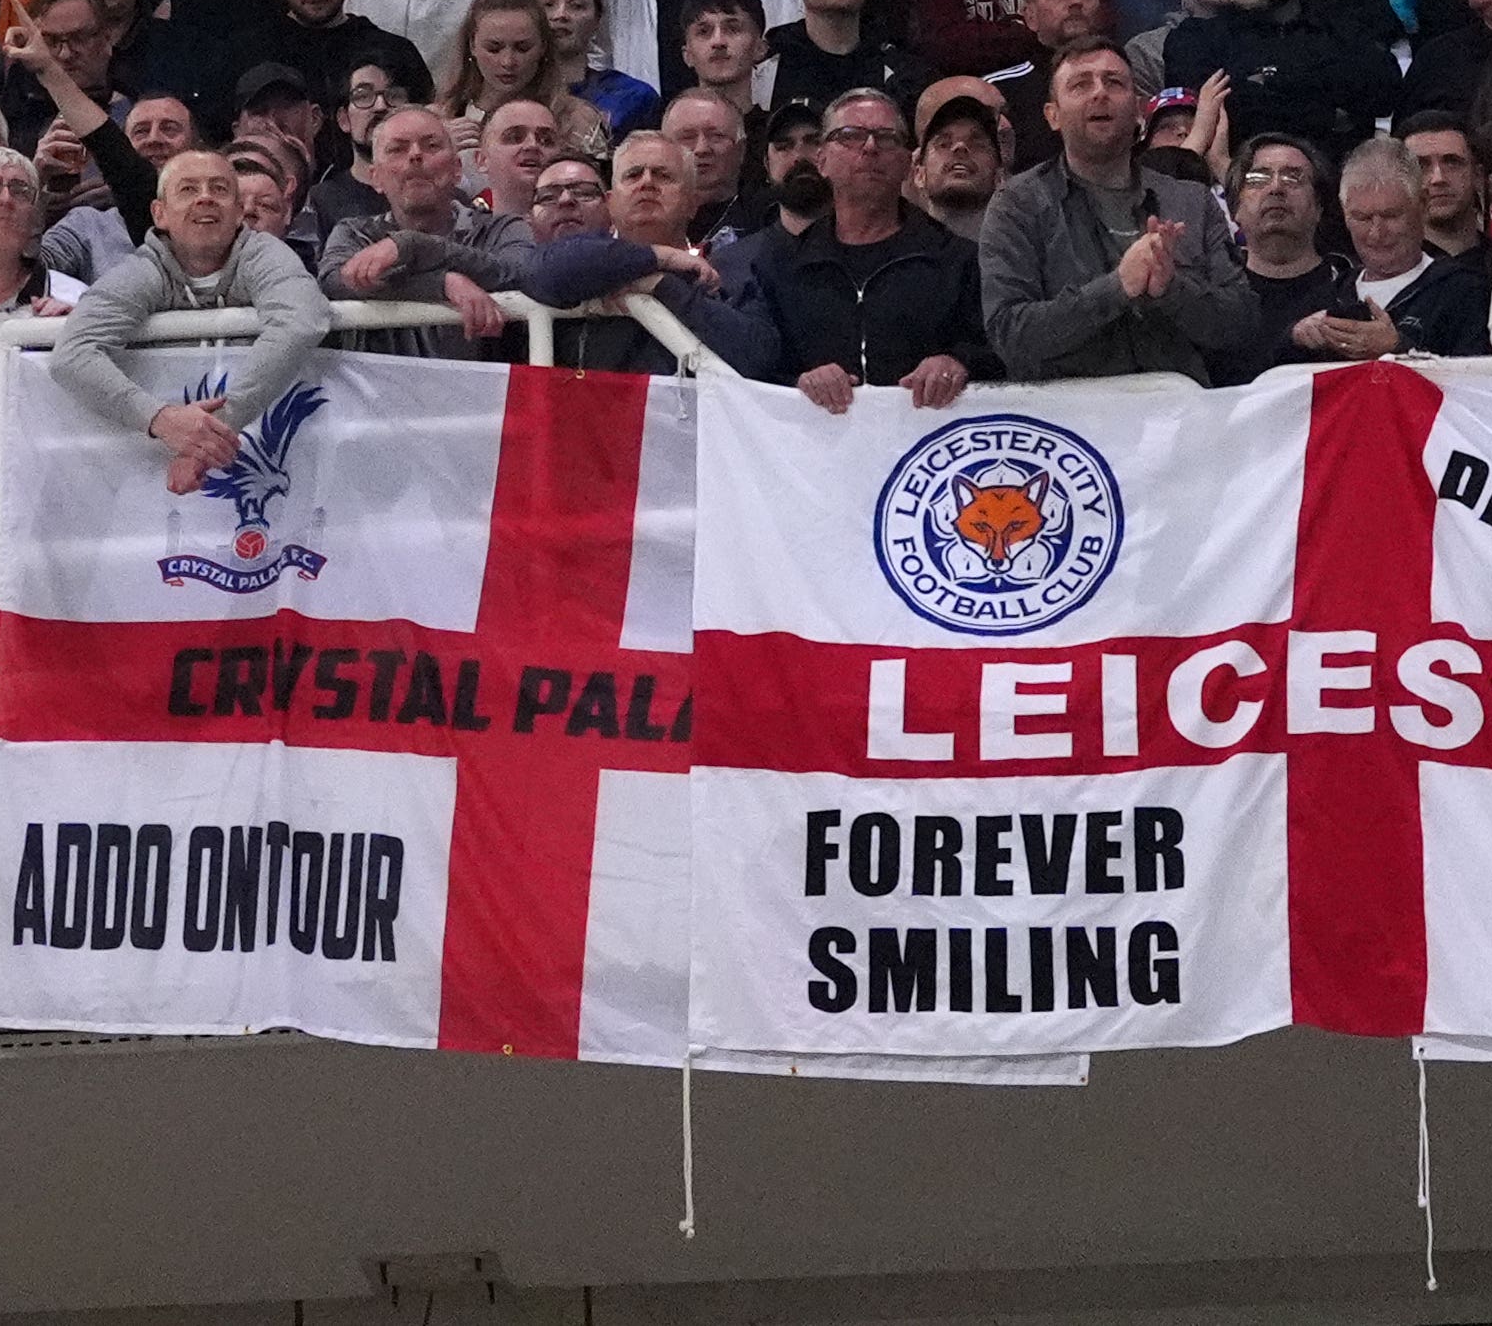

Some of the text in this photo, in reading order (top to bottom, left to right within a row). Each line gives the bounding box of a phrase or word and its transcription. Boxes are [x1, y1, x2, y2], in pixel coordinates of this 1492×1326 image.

[896, 430, 1107, 518] LEICESTER CITY
[167, 559, 234, 589] CRYSTAL
[893, 535, 1105, 620] FOOTBALL CLUB
[167, 636, 491, 733] CRYSTAL
[13, 820, 405, 963] ADDO ONTOUR
[804, 806, 1186, 898] FOREVER
[806, 920, 1182, 1015] SMILING
